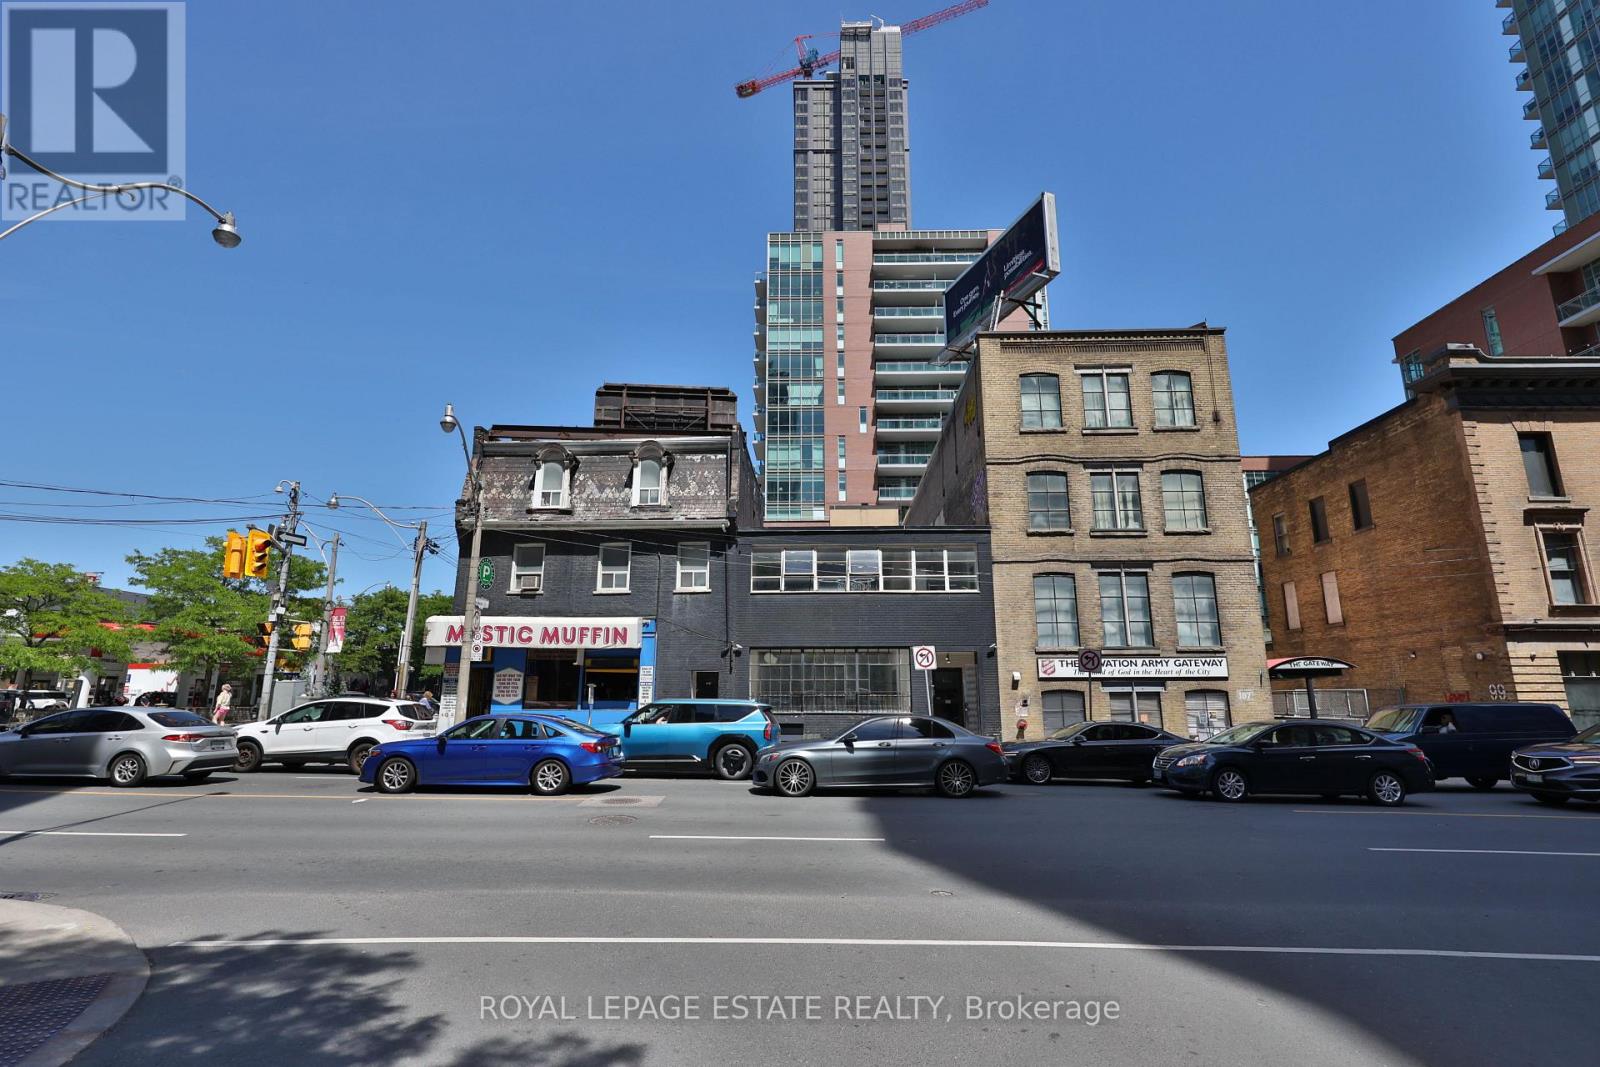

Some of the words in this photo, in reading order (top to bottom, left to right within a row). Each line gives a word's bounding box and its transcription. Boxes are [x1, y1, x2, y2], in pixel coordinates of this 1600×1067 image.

[445, 624, 533, 644] MSTIC
[539, 626, 628, 645] MUFFIN
[1141, 659, 1170, 667] ARMY
[1173, 659, 1224, 667] GATEWAY
